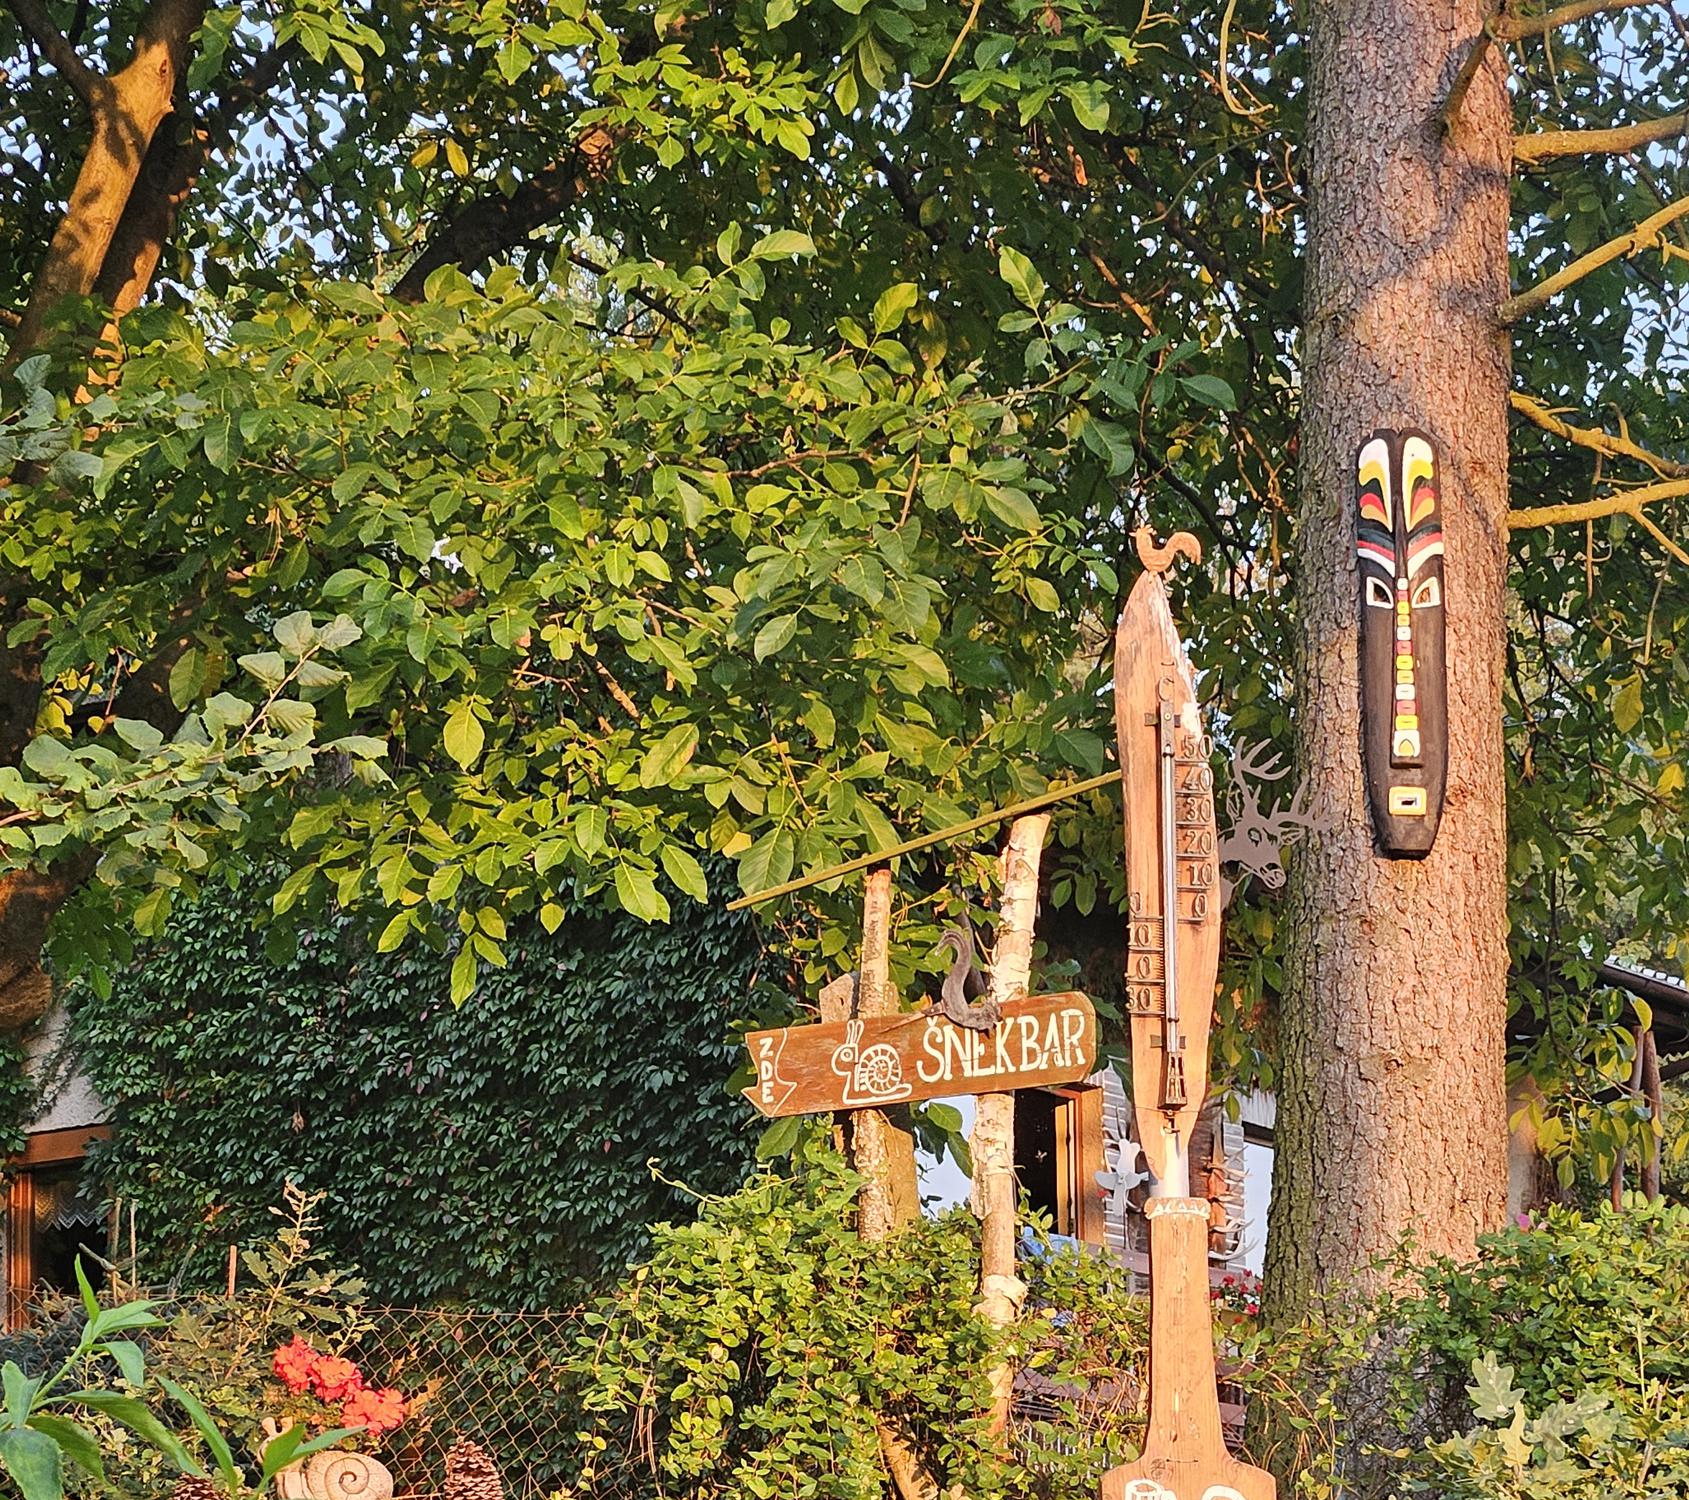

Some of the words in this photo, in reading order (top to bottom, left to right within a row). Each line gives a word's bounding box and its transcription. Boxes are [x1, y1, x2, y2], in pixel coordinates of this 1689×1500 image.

[1182, 734, 1213, 759] 50
[1183, 766, 1214, 792] 40
[1183, 797, 1212, 822] 30
[1183, 830, 1213, 855] 20
[1188, 862, 1213, 887] 10
[1192, 892, 1208, 917] 0
[1126, 921, 1150, 947] 10
[1125, 984, 1151, 1011] 30
[759, 1036, 775, 1105] ZDE
